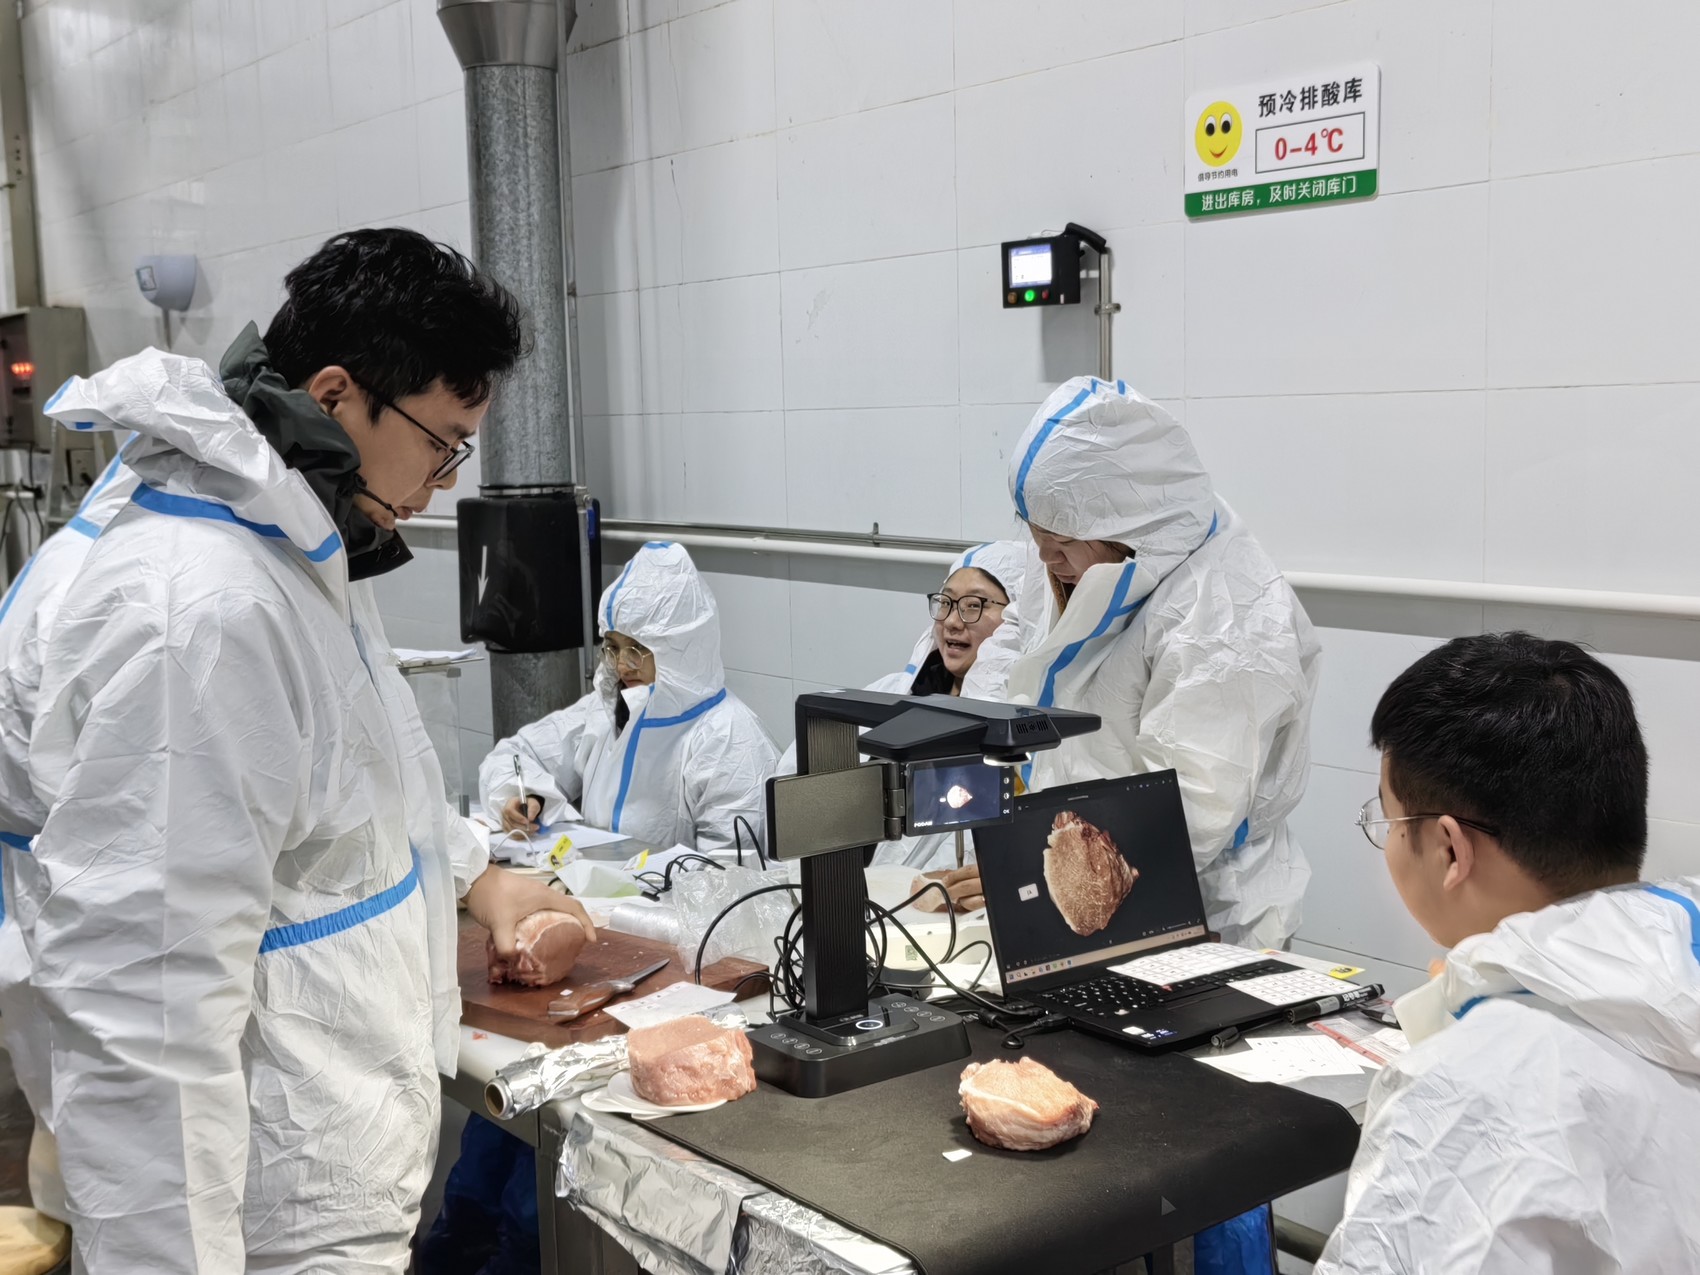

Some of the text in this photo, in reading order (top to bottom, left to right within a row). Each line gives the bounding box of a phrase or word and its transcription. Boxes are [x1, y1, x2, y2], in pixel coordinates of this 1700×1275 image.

[1258, 77, 1362, 118] 预冷排酸库
[1201, 175, 1356, 211] 进出库房，及时关闭库门
